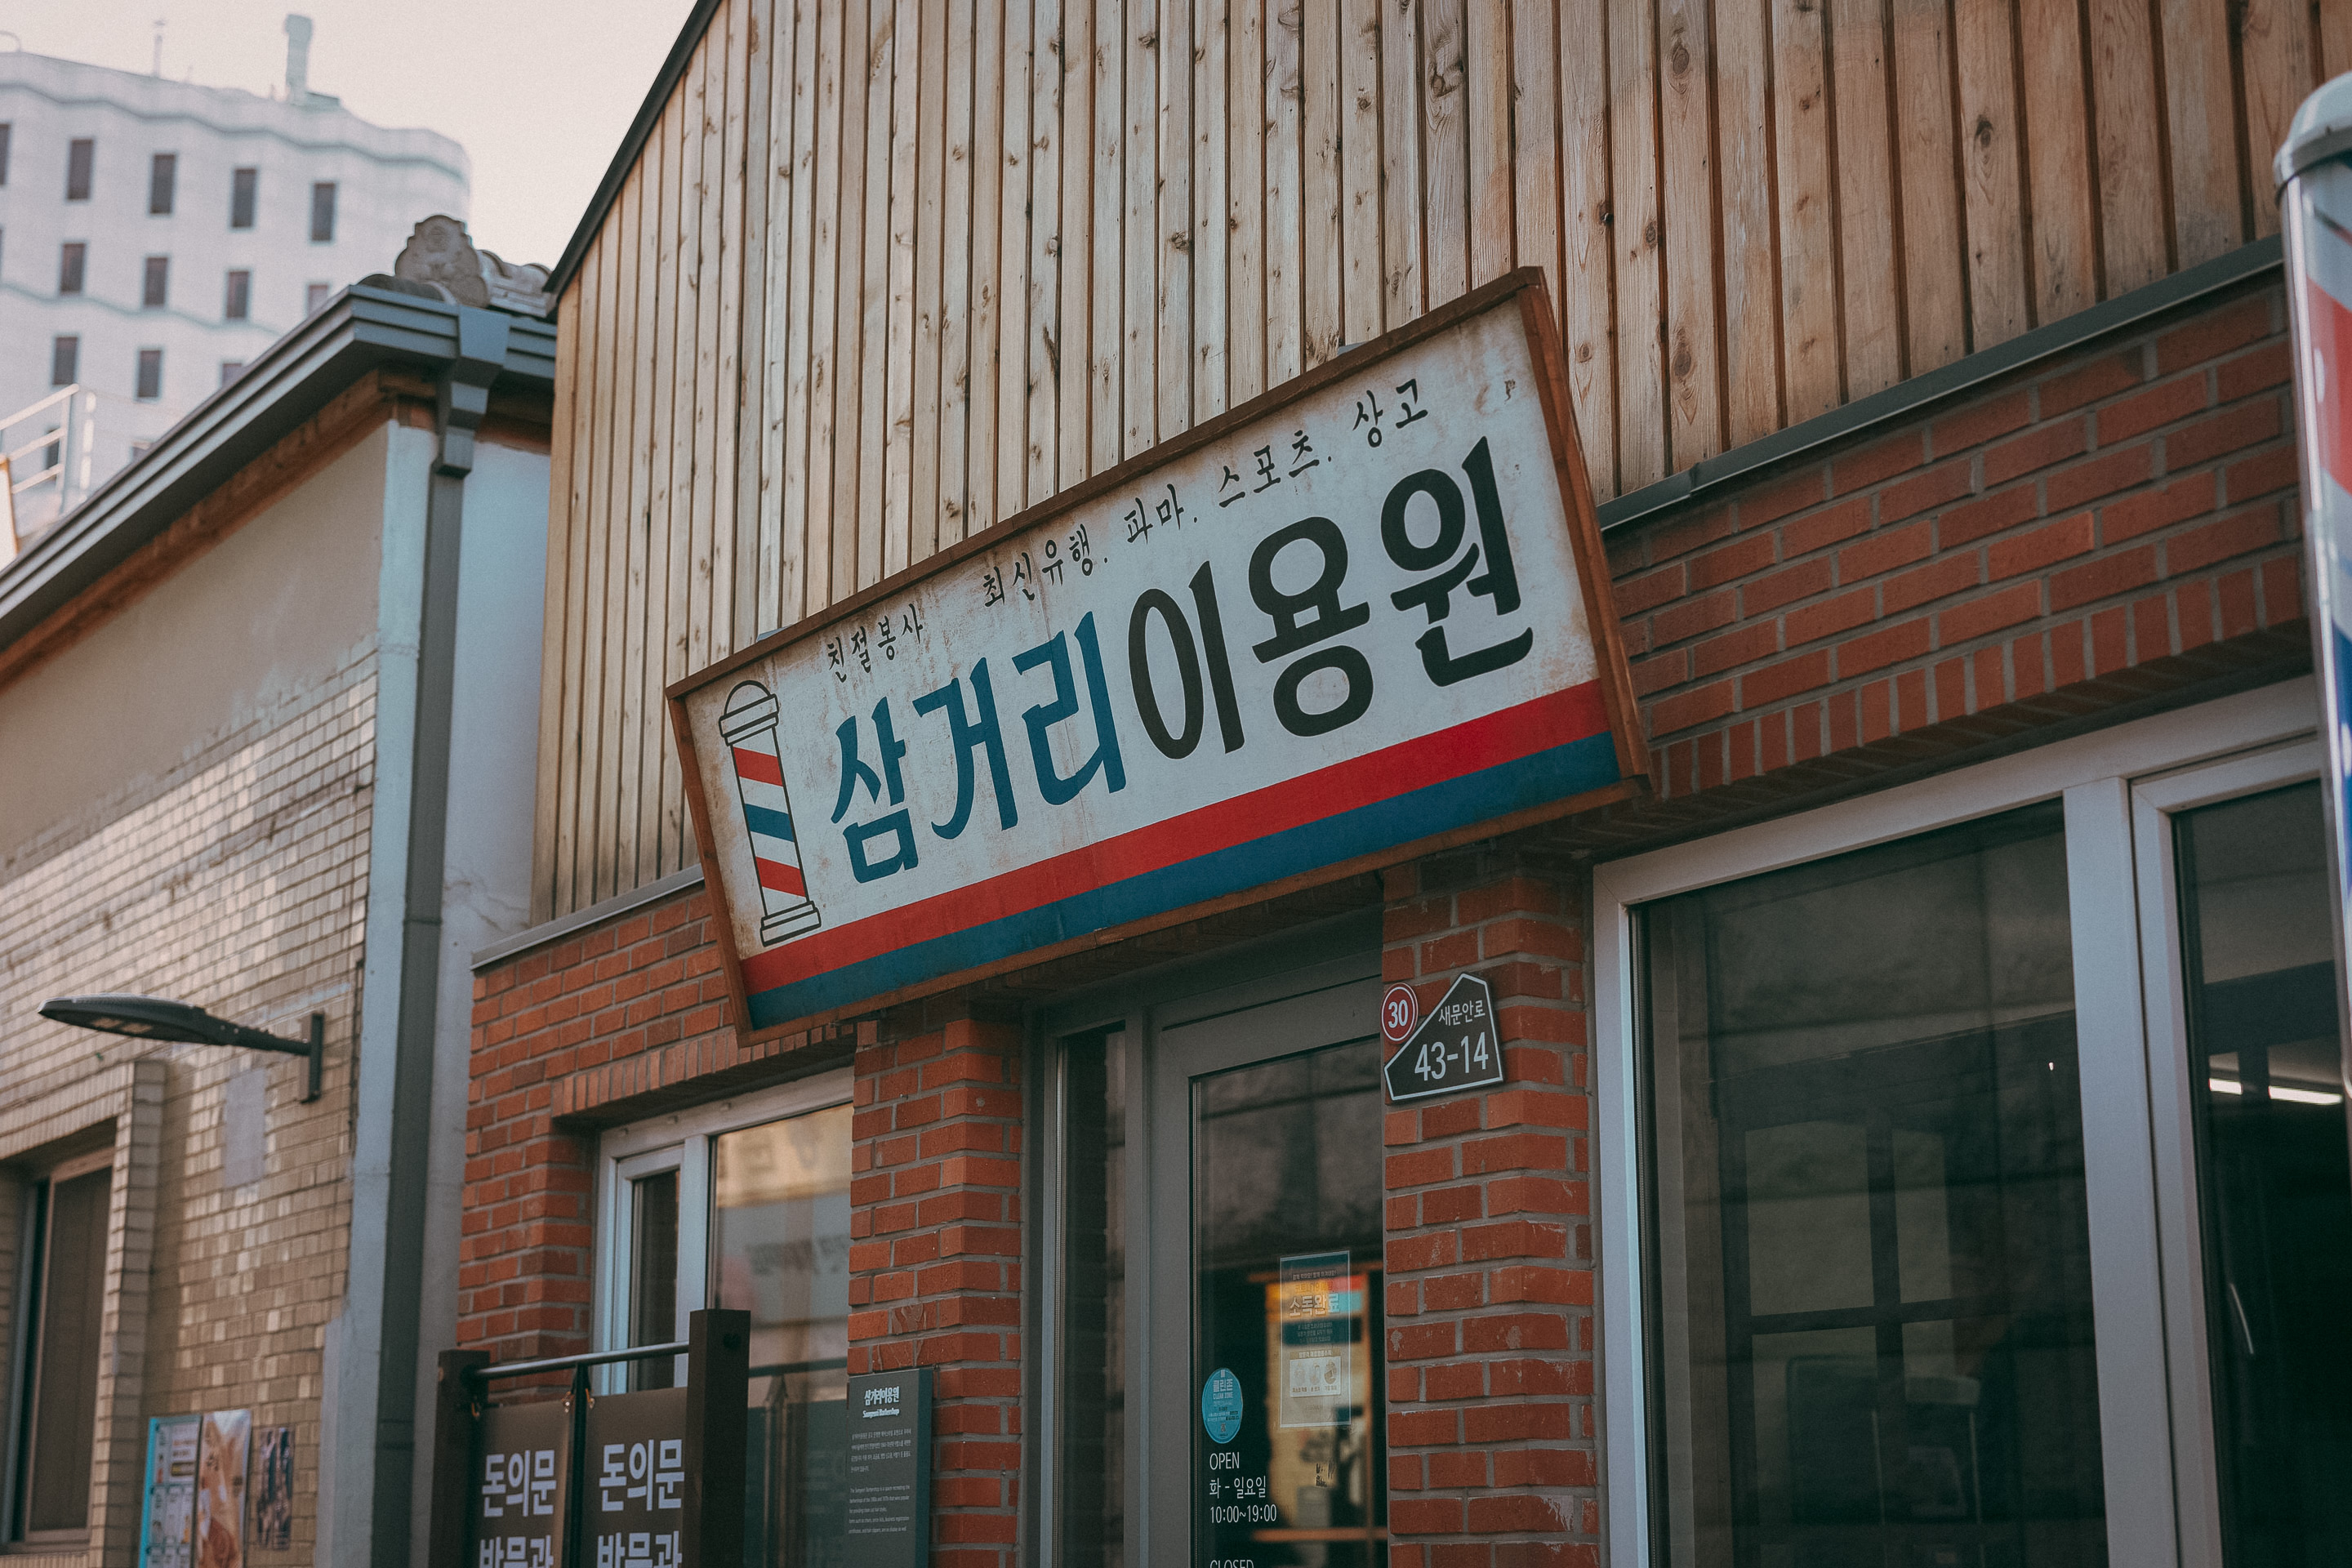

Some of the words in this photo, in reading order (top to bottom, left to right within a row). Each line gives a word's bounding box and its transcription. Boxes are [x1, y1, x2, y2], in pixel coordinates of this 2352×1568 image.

[826, 603, 924, 684] 친절봉사
[1352, 378, 1429, 448] 상고
[1388, 999, 1409, 1028] 30
[1438, 1000, 1486, 1027] 새문안로
[1414, 1031, 1489, 1081] 43-14
[1289, 1292, 1340, 1317] 소독완료
[864, 1385, 900, 1406] 삼거리이용원
[1209, 1451, 1240, 1470] OPEN
[482, 1450, 557, 1517] 돈의문
[599, 1439, 685, 1512] 돈의문
[1233, 1475, 1266, 1499] 일요일
[1209, 1503, 1277, 1524] 10:00~19:00
